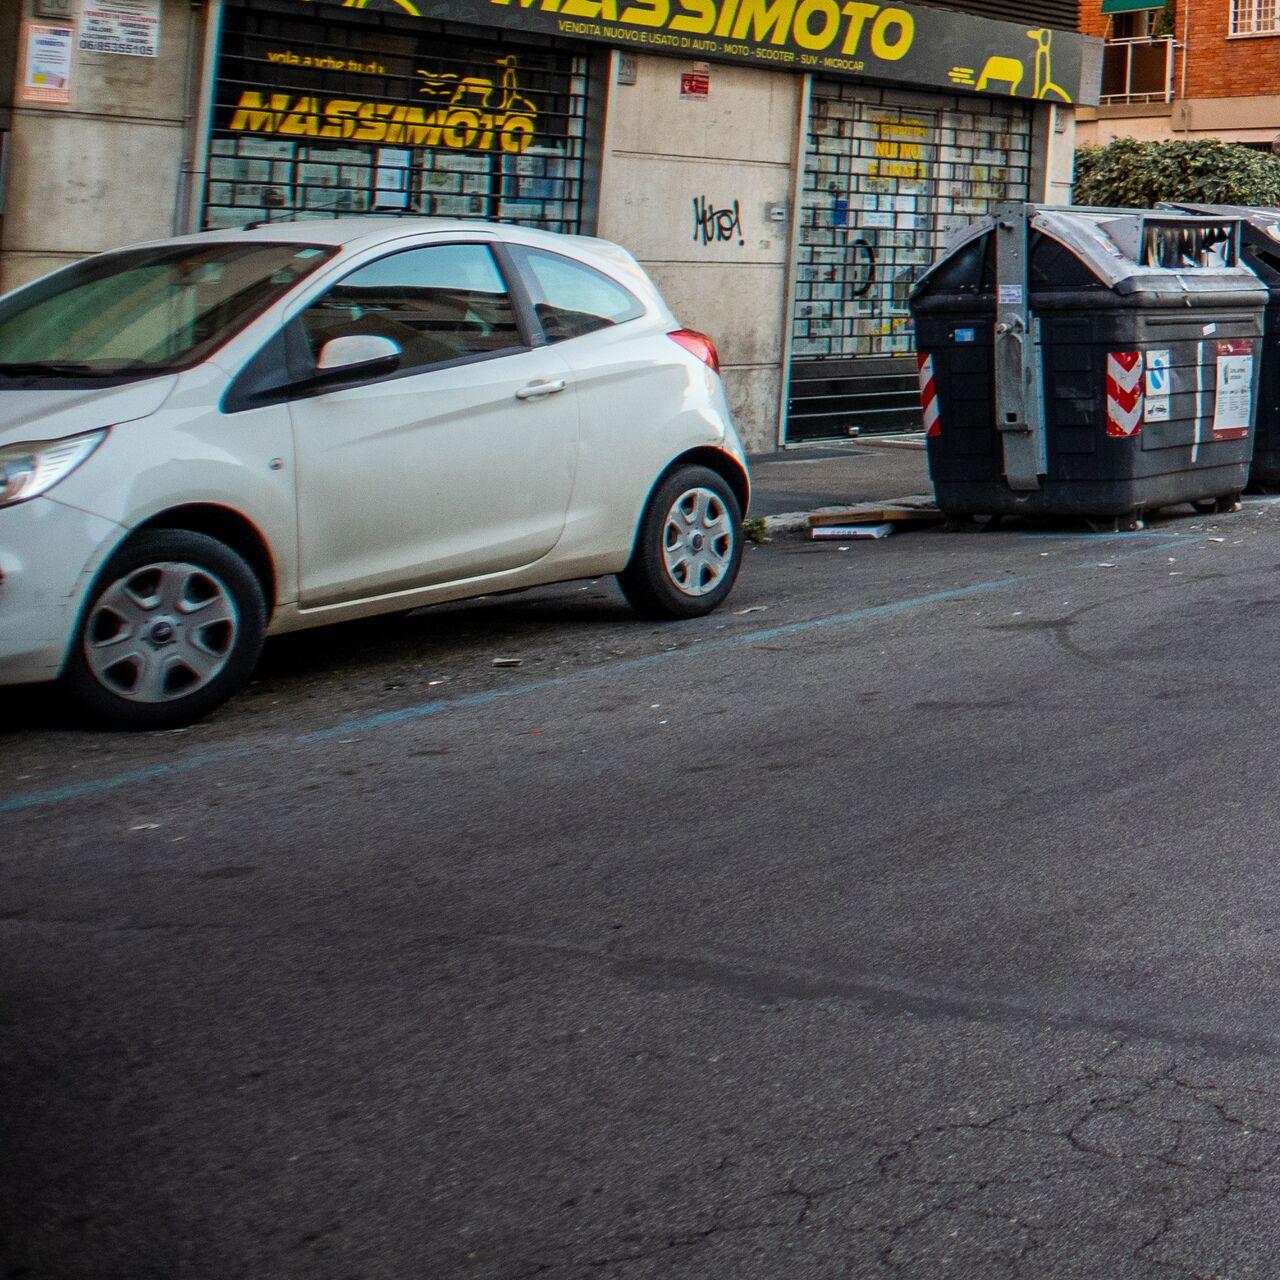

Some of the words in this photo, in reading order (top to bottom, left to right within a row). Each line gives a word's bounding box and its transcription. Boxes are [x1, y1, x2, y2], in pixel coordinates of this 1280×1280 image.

[558, 20, 601, 37] VENDITA
[603, 26, 639, 42] NUOVO
[640, 31, 648, 43] E
[649, 33, 680, 48] USATO
[681, 37, 691, 48] DI
[693, 40, 717, 53] AUTO
[723, 43, 750, 57] MOTO
[755, 47, 796, 63] SCOOTER
[800, 54, 819, 66] SUV
[823, 57, 865, 72] MICROCAR
[229, 90, 536, 153] MASSIMOTO
